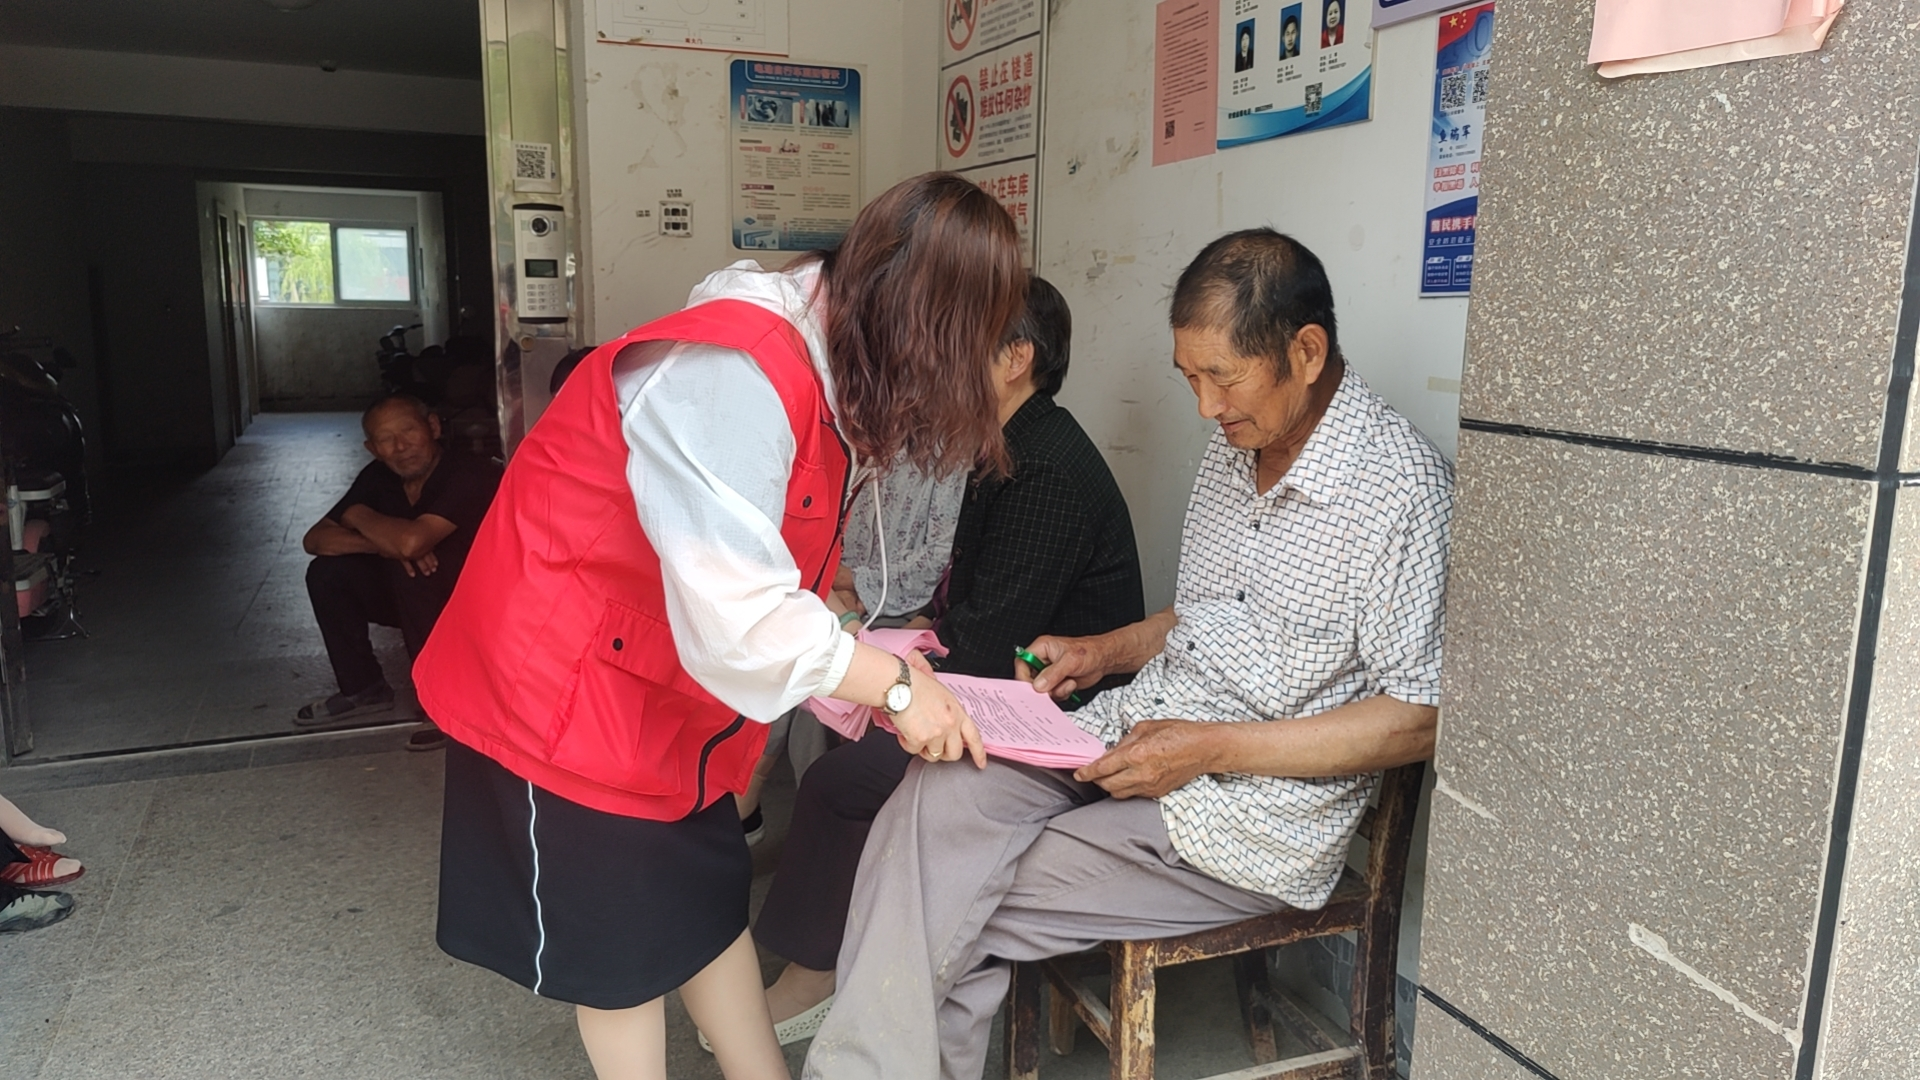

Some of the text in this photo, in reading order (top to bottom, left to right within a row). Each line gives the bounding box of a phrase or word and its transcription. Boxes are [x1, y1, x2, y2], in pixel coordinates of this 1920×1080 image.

[979, 51, 1033, 92] 禁止在楼道
[979, 82, 1032, 119] 堆放任何杂物
[1430, 215, 1476, 233] 警民携手
